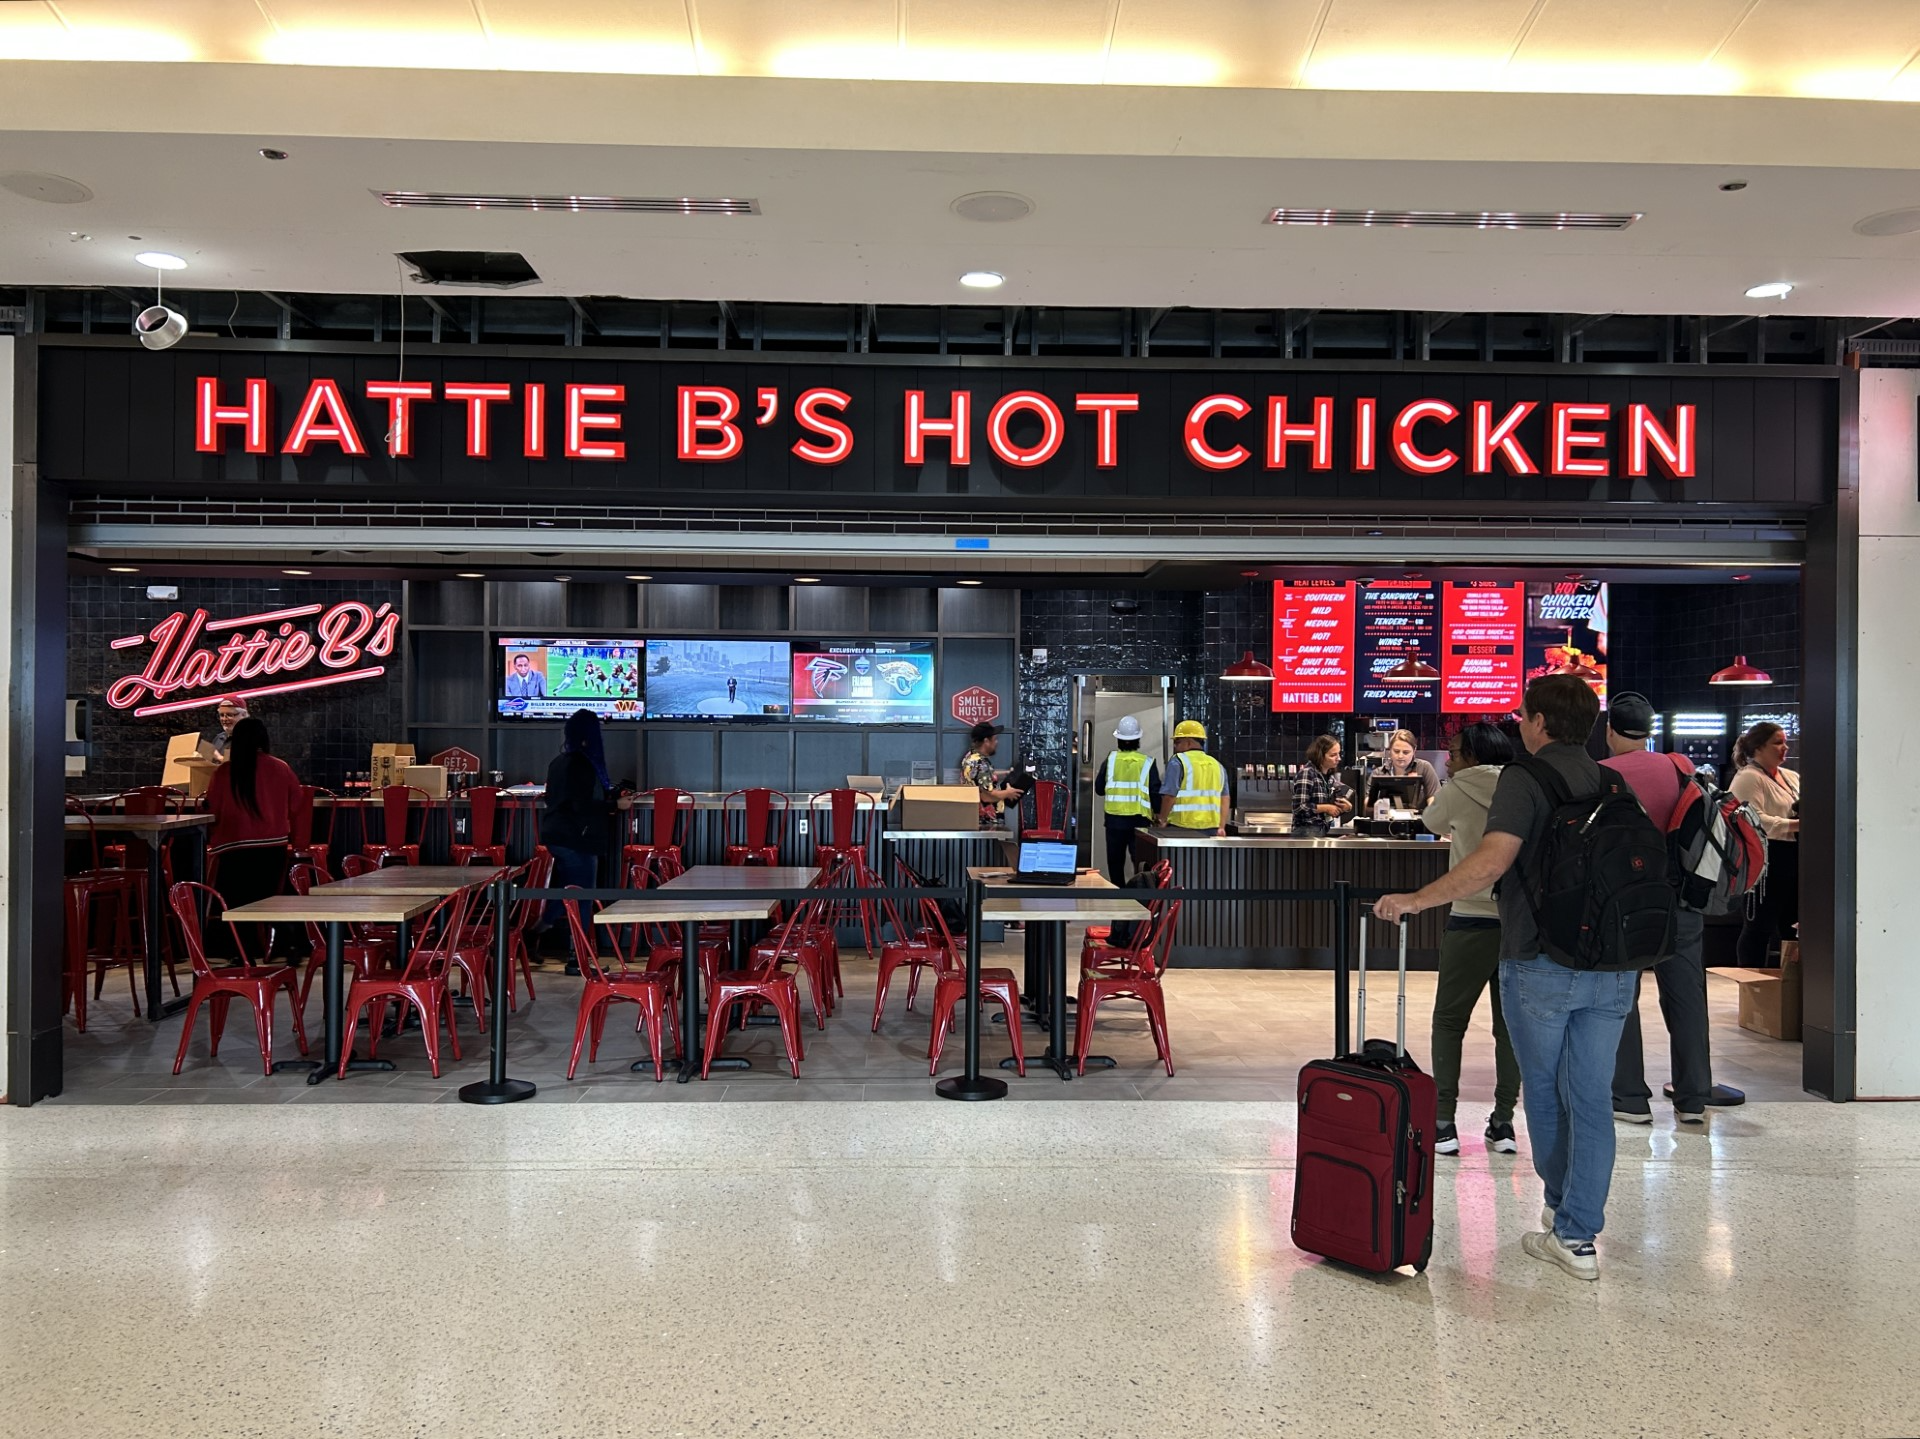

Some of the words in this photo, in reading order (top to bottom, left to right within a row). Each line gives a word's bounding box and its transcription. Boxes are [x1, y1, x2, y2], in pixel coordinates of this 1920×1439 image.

[195, 376, 627, 459] HATTIE
[677, 385, 854, 465] B'S
[904, 390, 1139, 468] HOT
[1183, 393, 1697, 479] CHICKEN
[1554, 582, 1580, 594] HOT
[1304, 593, 1346, 602] SOUTHERN
[1364, 592, 1380, 600] THE
[1380, 592, 1419, 600] SANDWICH
[1540, 594, 1596, 606] CHICKEN
[1310, 606, 1332, 614] MILD
[1539, 607, 1595, 619] TENDERS
[1304, 619, 1339, 628] MEDIUM
[1374, 617, 1408, 625] TENDERS
[1311, 632, 1331, 640] HOT!
[1378, 638, 1403, 646] WINGS
[1298, 645, 1322, 653] DAMN
[1468, 646, 1497, 654] DESSERT
[106, 608, 318, 709] Hattie
[317, 600, 400, 668] B's
[1301, 658, 1323, 666] SHUT
[1324, 658, 1340, 666] THE
[1463, 658, 1493, 666] BANANA
[1294, 667, 1320, 676] CLUCK
[1282, 692, 1342, 703] HATTIEB.COM
[1363, 690, 1386, 698] FRIED
[1387, 690, 1418, 698] PICKLES
[958, 695, 986, 707] SMILE
[958, 706, 993, 717] HUSTLE
[443, 756, 461, 767] GET
